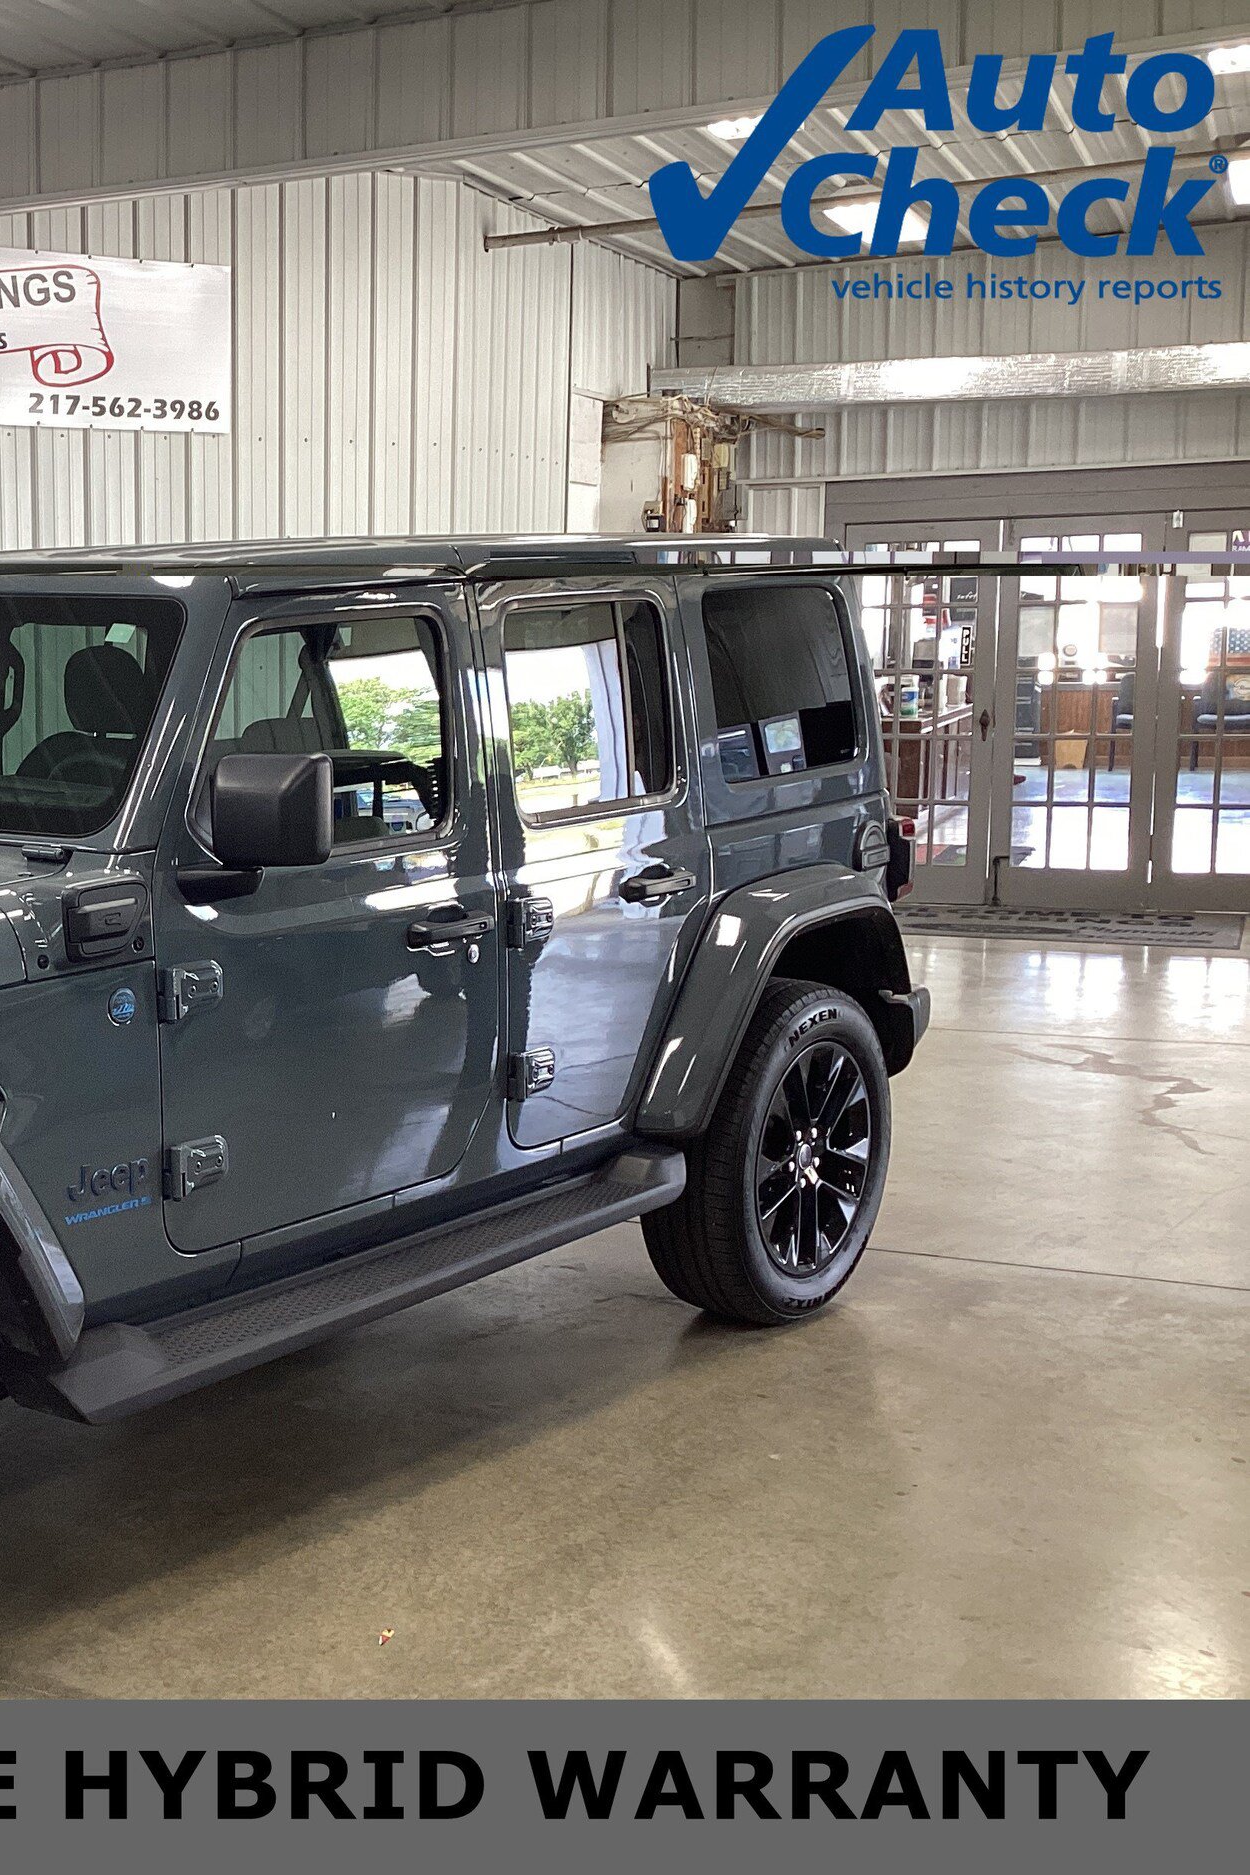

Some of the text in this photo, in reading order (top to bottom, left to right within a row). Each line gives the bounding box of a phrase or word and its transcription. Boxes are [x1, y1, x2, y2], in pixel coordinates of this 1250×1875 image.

[29, 392, 220, 422] 217-562-3986
[962, 629, 970, 662] PULL
[788, 1008, 837, 1048] NEXEN
[68, 1157, 150, 1202] Jeep
[64, 1198, 140, 1226] WRANGLER
